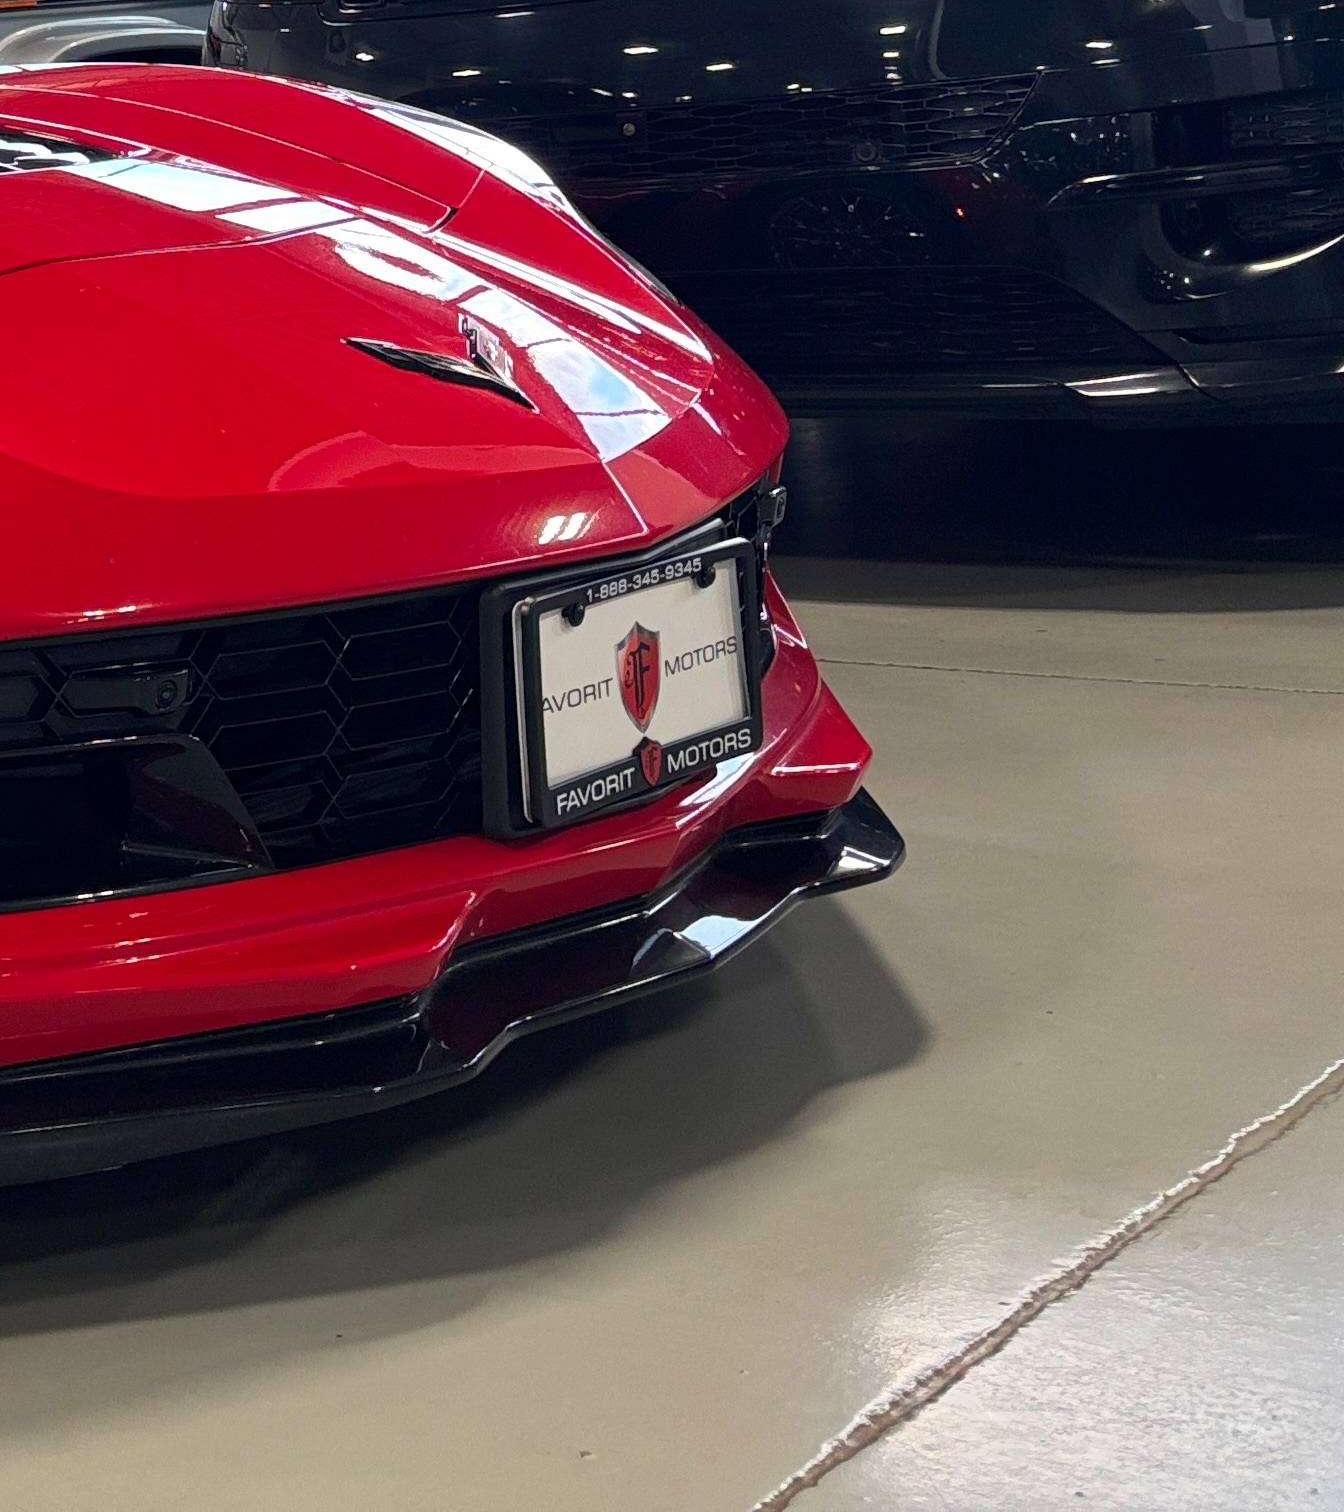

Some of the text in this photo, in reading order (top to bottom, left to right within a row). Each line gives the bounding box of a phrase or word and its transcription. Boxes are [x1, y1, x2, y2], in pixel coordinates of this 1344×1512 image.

[586, 557, 702, 604] 1-888-345-9345
[541, 677, 613, 714] AVORIT
[664, 635, 738, 678] MOTORS
[556, 767, 635, 817] FAVORIT
[666, 728, 752, 774] MOTORS
